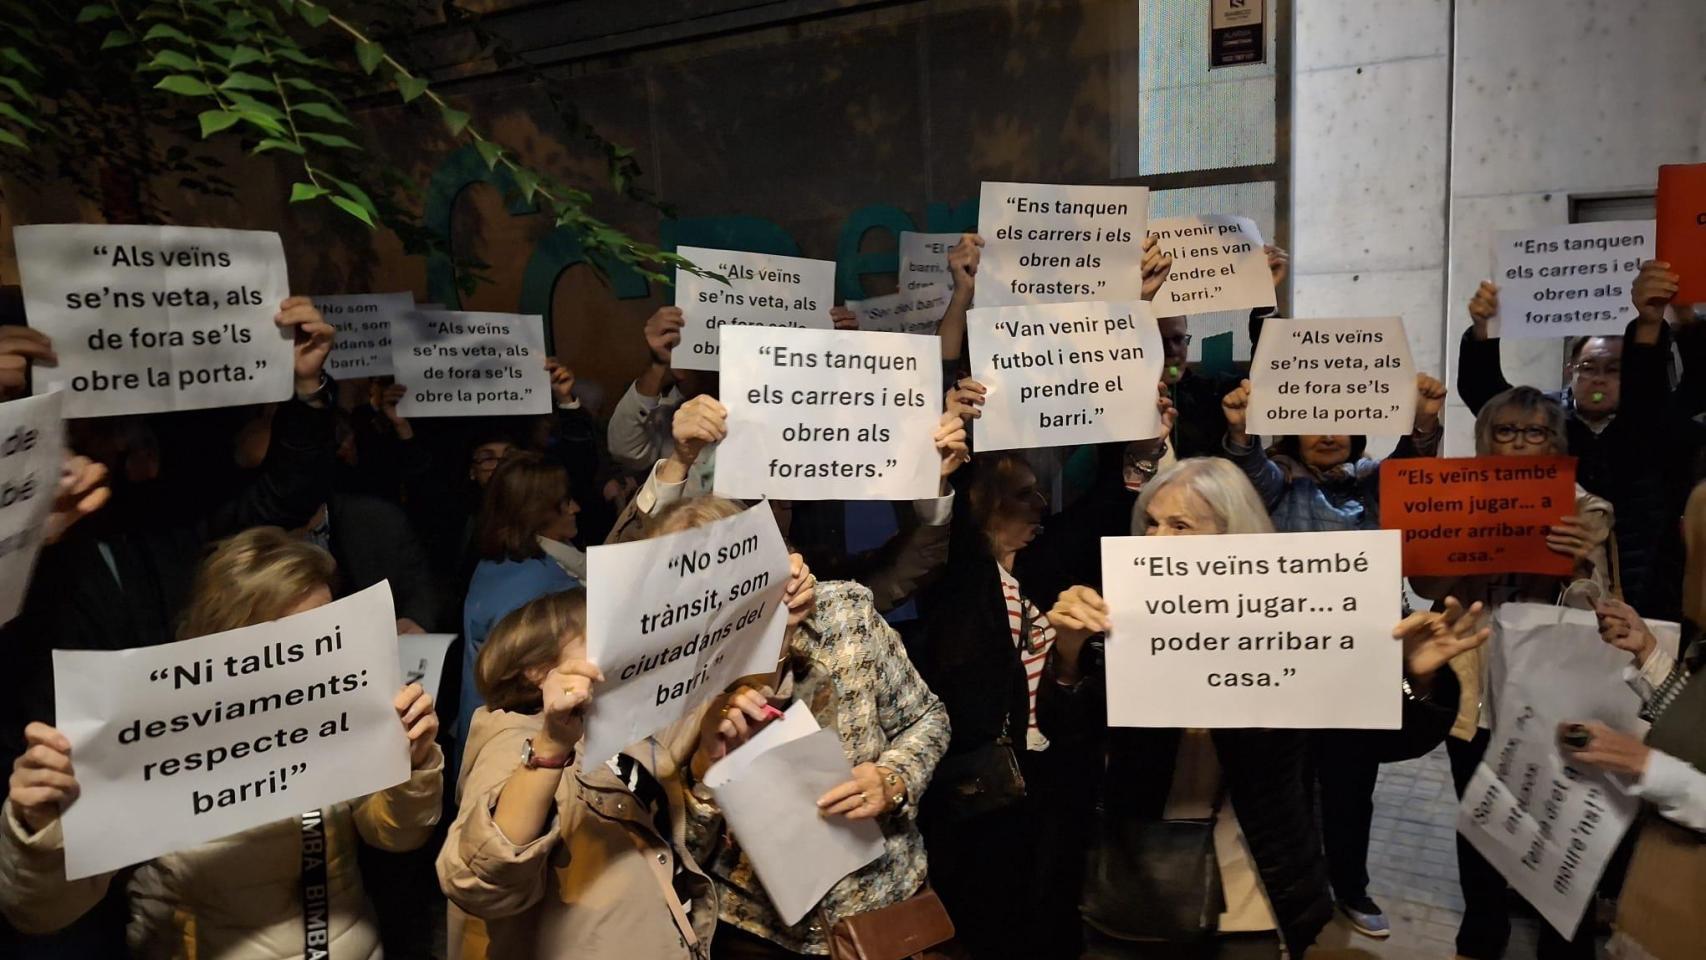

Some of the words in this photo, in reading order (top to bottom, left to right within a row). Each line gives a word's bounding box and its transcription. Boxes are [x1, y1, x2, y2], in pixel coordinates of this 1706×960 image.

[1007, 197, 1050, 214] “Ens
[1055, 200, 1128, 219] tanquen
[997, 225, 1023, 241] els
[1028, 230, 1092, 242] carrers
[1096, 228, 1102, 242] i
[1106, 228, 1131, 243] els
[1174, 224, 1215, 238] venir
[1218, 224, 1243, 237] pel
[1182, 247, 1186, 259] i
[1190, 247, 1219, 258] ens
[1222, 243, 1252, 255] van
[1514, 240, 1559, 254] “Ens
[1564, 235, 1645, 252] tanquen
[93, 245, 155, 268] “Als
[159, 246, 231, 268] veïns
[1019, 252, 1071, 268] obren
[1075, 254, 1101, 269] als
[719, 264, 754, 280] “Als
[758, 269, 801, 285] veïns
[1220, 263, 1236, 276] el
[1506, 265, 1534, 280] els
[1538, 263, 1609, 278] carrers
[1614, 263, 1618, 273] i
[1624, 261, 1643, 273] el
[66, 287, 146, 310] se’ns
[152, 288, 220, 310] veta,
[226, 286, 263, 307] als
[1011, 280, 1106, 295] forasters.”
[1171, 286, 1222, 303] barri.”
[1533, 288, 1589, 302] obren
[1594, 284, 1623, 298] als
[699, 290, 745, 306] se’ns
[749, 295, 789, 312] veta,
[793, 297, 817, 312] als
[1525, 306, 1630, 324] forasters.”
[427, 321, 464, 336] “Als
[467, 323, 510, 335] veïns
[995, 321, 1045, 338] “Van
[1049, 317, 1099, 335] venir
[1104, 314, 1136, 335] pel
[88, 329, 123, 351] de
[129, 327, 185, 349] fora
[192, 324, 252, 347] se’ls
[1293, 331, 1330, 345] “Als
[1335, 330, 1384, 344] veïns
[413, 344, 459, 357] se’ns
[462, 345, 502, 359] veta,
[506, 344, 529, 357] als
[759, 346, 818, 368] “Ens
[825, 351, 917, 375] tanquen
[992, 350, 1055, 370] futbol
[1058, 349, 1064, 365] i
[1069, 345, 1105, 365] ens
[1109, 343, 1144, 361] van
[424, 367, 445, 380] de
[448, 367, 482, 380] fora
[484, 366, 523, 379] se’ls
[1271, 356, 1324, 371] se’ns
[1324, 357, 1369, 371] veta,
[1374, 354, 1401, 369] als
[71, 370, 140, 393] obre
[147, 367, 171, 388] la
[179, 360, 267, 391] porta.”
[415, 389, 454, 403] obre
[457, 389, 472, 402] la
[477, 388, 533, 405] porta.”
[748, 384, 784, 405] els
[791, 386, 875, 407] carrers
[882, 388, 888, 407] i
[894, 388, 925, 408] els
[1019, 378, 1099, 404] prendre
[1104, 375, 1124, 393] el
[1278, 381, 1300, 395] de
[1305, 381, 1341, 395] fora
[1347, 380, 1390, 394] se’ls
[1040, 408, 1104, 429] barri.”
[1267, 406, 1308, 420] obre
[1313, 406, 1329, 420] la
[1334, 405, 1400, 423] porta.”
[783, 423, 850, 442] obren
[857, 424, 890, 443] als
[769, 459, 897, 478] forasters.”
[1398, 469, 1434, 485] “Els
[1440, 467, 1490, 485] veïns
[1495, 463, 1559, 481] també
[1404, 497, 1464, 514] volem
[1469, 496, 1536, 515] jugar...
[1542, 497, 1552, 509] a
[1405, 525, 1463, 544] poder
[1468, 523, 1536, 539] arribar
[668, 550, 711, 578] “No
[717, 535, 758, 565] som
[1134, 557, 1189, 577] “Els
[1196, 555, 1270, 576] veïns
[1277, 551, 1369, 574] també
[1447, 546, 1507, 566] casa.”
[641, 590, 727, 635] trànsit,
[729, 571, 769, 602] som
[1145, 595, 1229, 615] volem
[1236, 594, 1333, 619] jugar...
[1343, 597, 1357, 612] a
[620, 622, 734, 682] ciutadans
[736, 601, 766, 632] del
[1151, 632, 1231, 656] poder
[1238, 631, 1332, 651] arribar
[1340, 635, 1354, 650] a
[150, 659, 213, 690] “Ni
[224, 642, 305, 678] talls
[315, 625, 342, 657] ni
[656, 654, 725, 707] barri.”
[1208, 668, 1296, 688] casa.”
[118, 667, 368, 748] desviaments:
[144, 720, 309, 783] respecte
[319, 712, 350, 738] al
[193, 762, 307, 816] barri!”
[301, 810, 325, 873] IMBA
